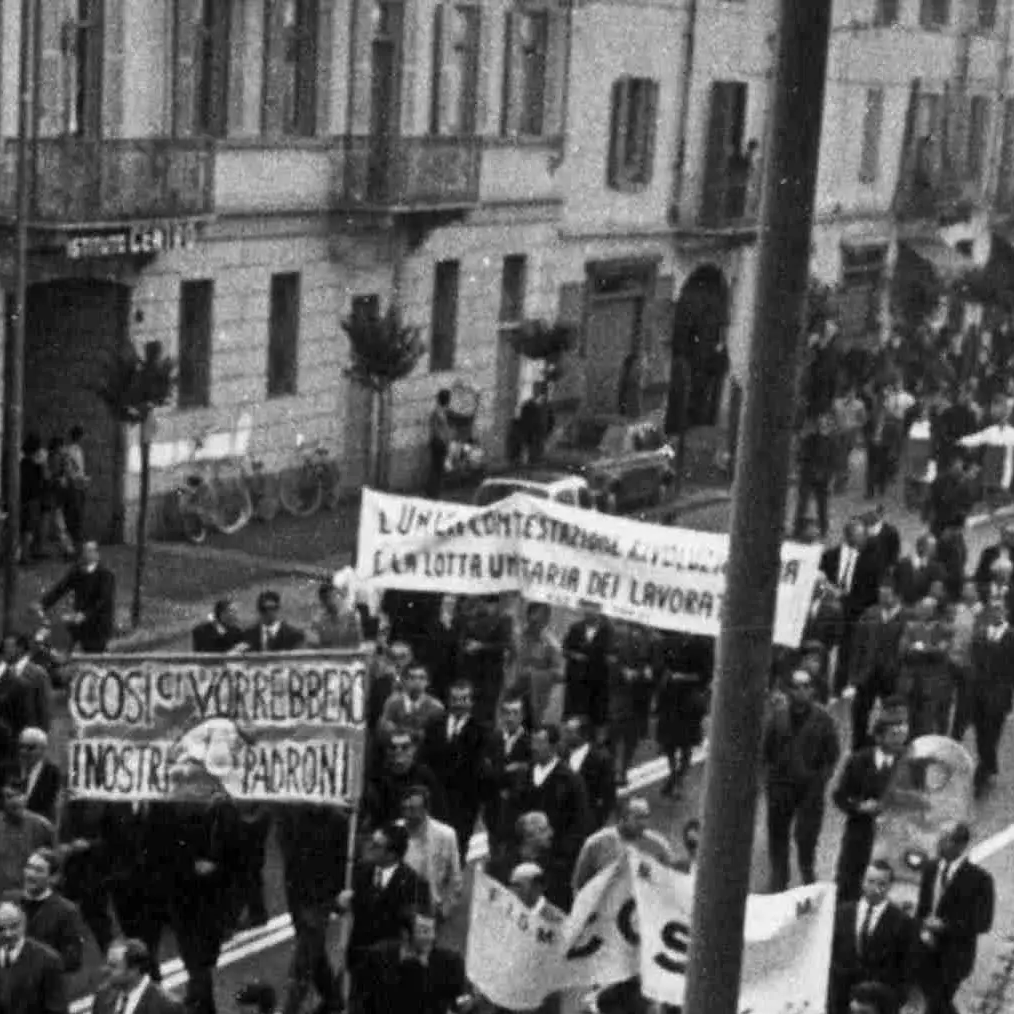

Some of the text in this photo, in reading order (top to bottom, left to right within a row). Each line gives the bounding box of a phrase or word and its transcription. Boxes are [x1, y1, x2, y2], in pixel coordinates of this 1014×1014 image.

[423, 551, 482, 580] LOTTA
[588, 568, 620, 599] DEI
[241, 743, 349, 795] PADRONI
